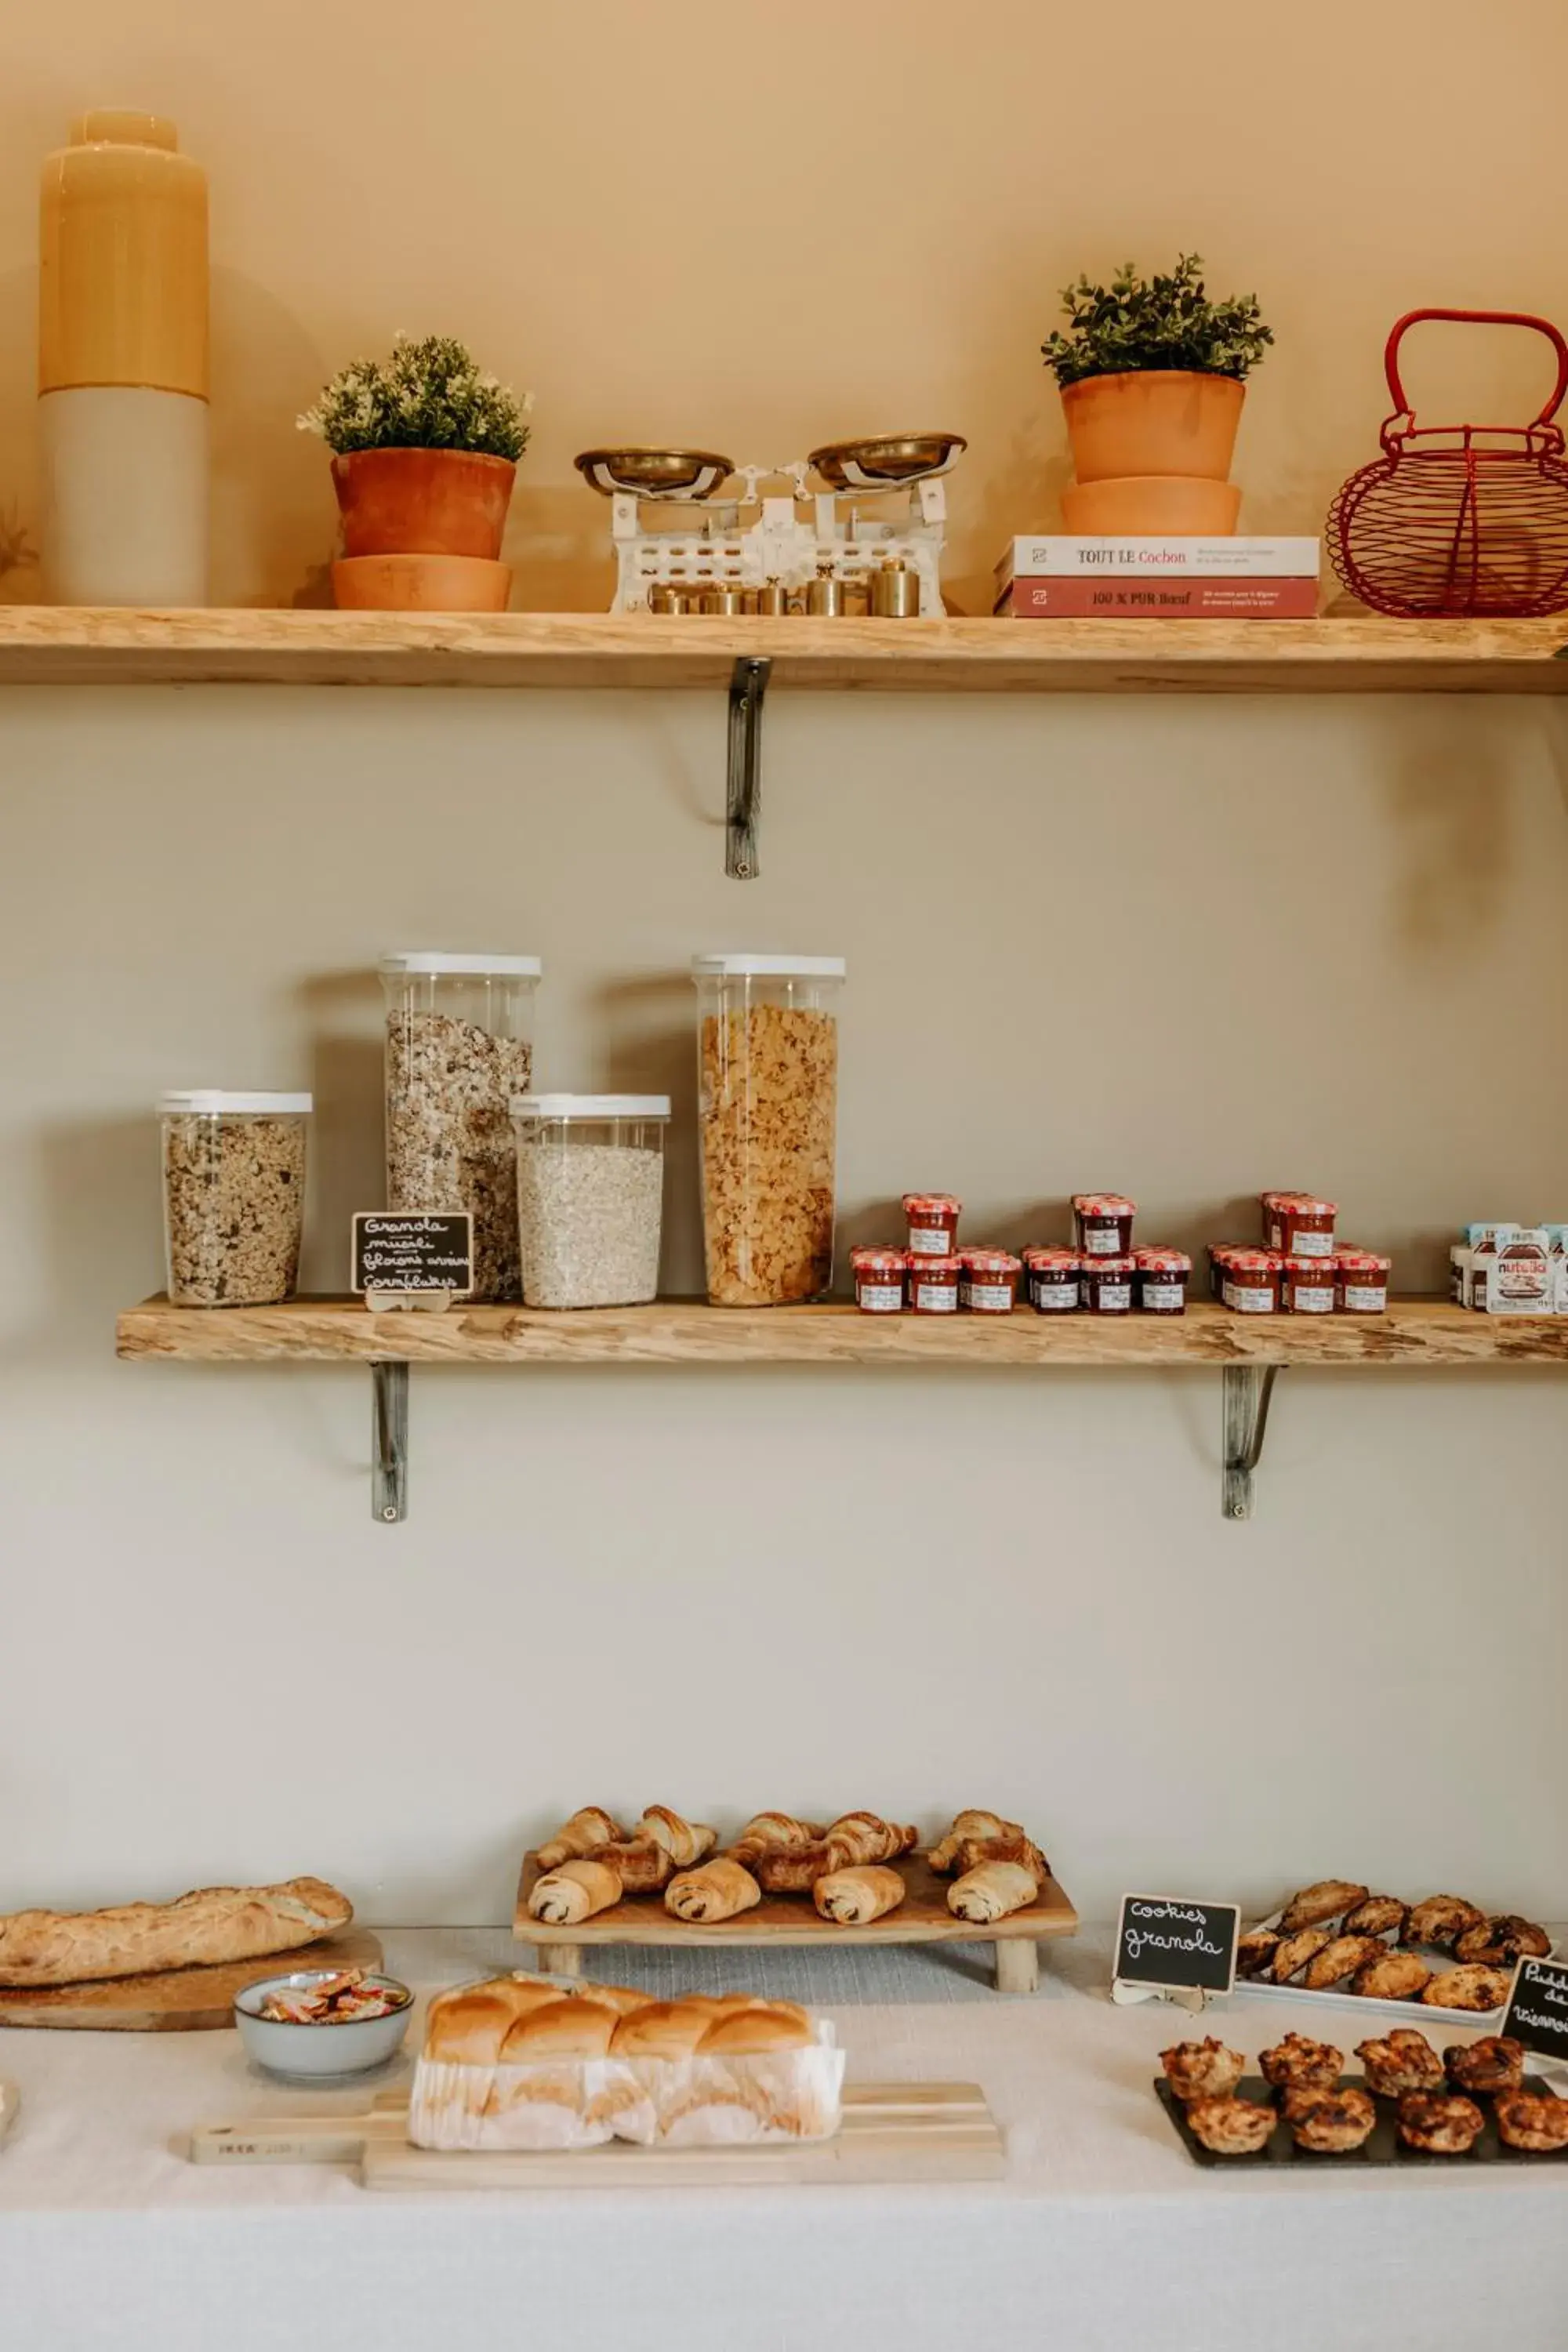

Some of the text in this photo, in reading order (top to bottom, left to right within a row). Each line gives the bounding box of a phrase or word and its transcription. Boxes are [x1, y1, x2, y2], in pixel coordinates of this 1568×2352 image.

[1078, 549, 1115, 564] TOUT
[1119, 549, 1136, 564] LE
[1138, 547, 1187, 564] Cochon
[1092, 592, 1113, 604] 100
[1131, 592, 1156, 604] PUR
[365, 1217, 449, 1233] Granola
[1125, 1928, 1224, 1958] granola
